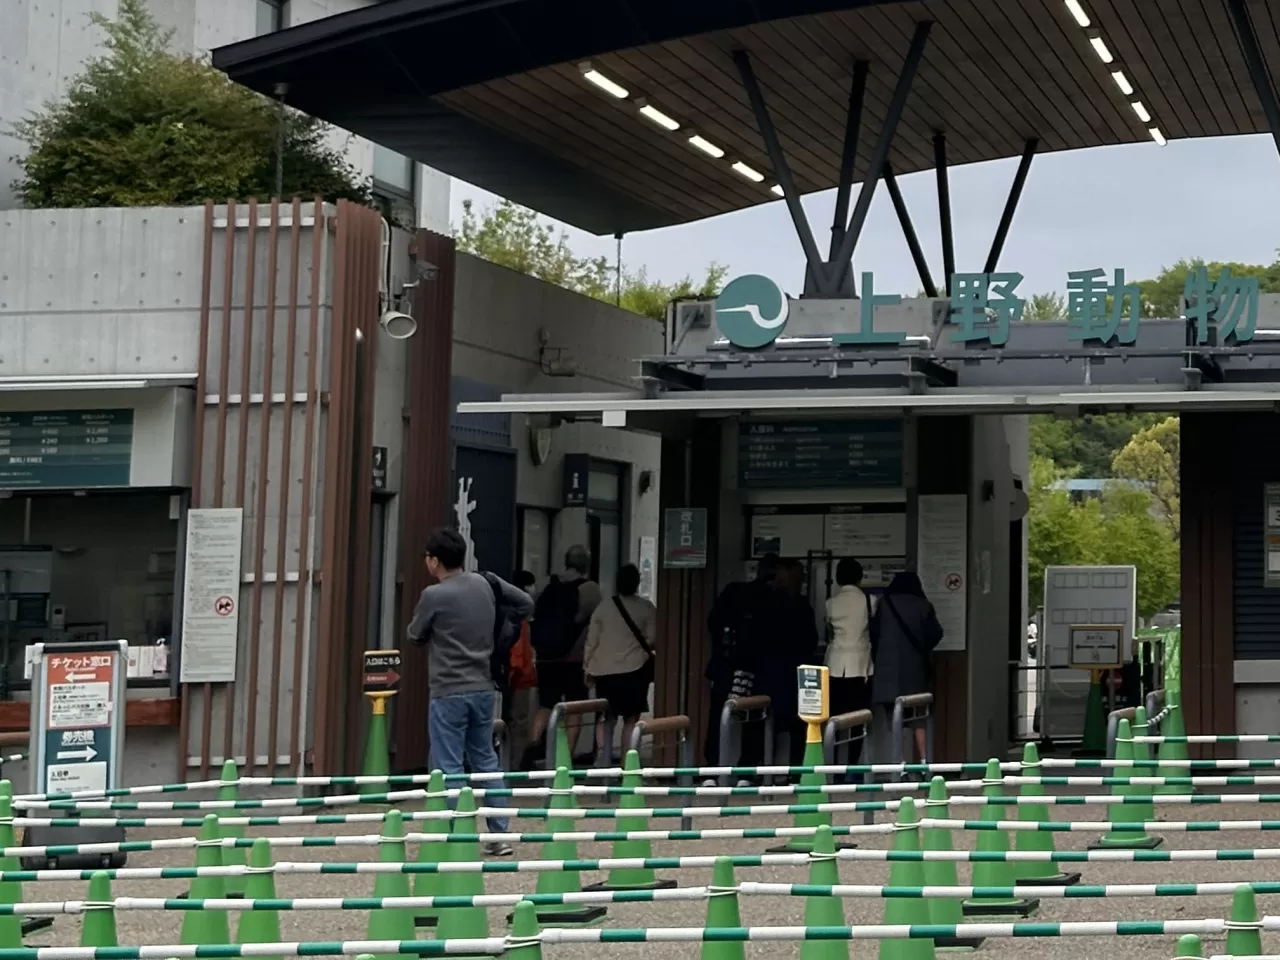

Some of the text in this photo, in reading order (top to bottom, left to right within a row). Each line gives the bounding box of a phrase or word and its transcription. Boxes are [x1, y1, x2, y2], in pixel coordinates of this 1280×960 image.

[51, 656, 111, 668] チケット窓口
